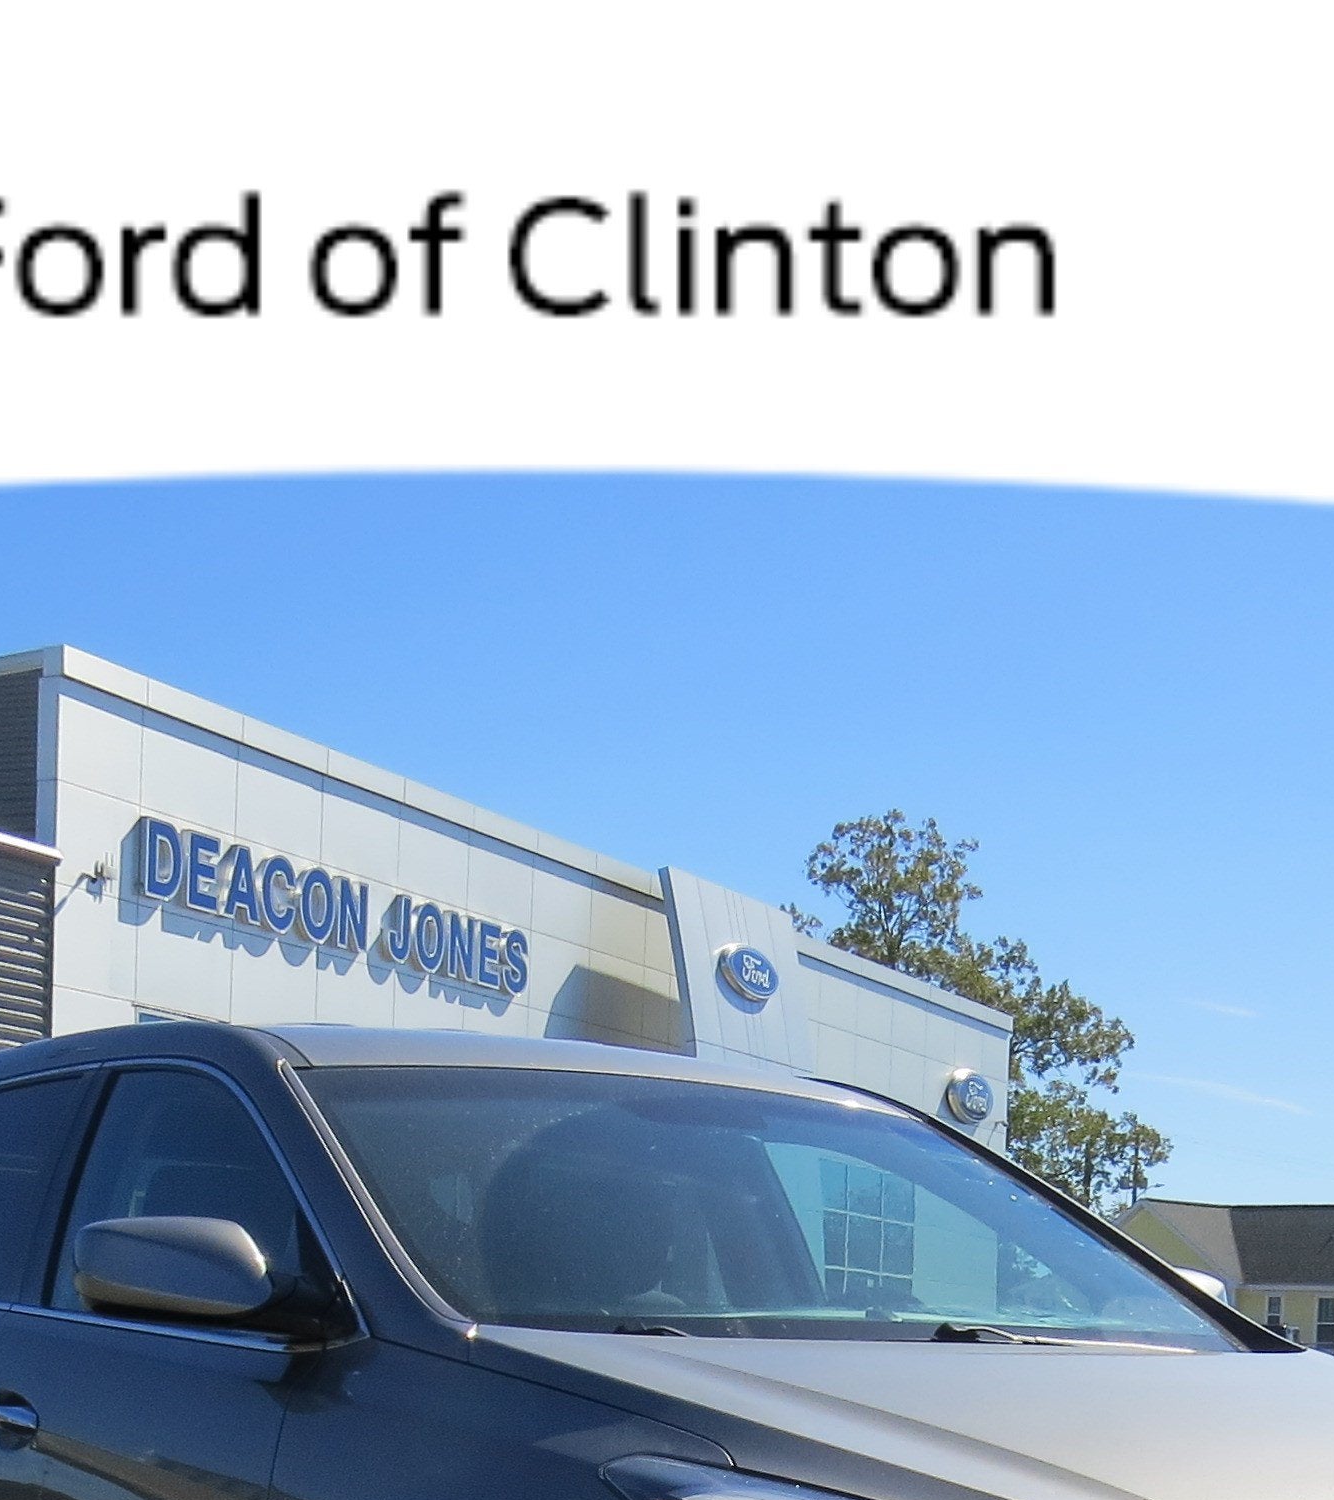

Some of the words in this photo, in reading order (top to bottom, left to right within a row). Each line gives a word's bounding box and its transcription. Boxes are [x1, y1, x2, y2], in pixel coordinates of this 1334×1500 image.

[140, 816, 369, 954] DEACON
[383, 894, 529, 998] JONES
[742, 954, 771, 989] Ford
